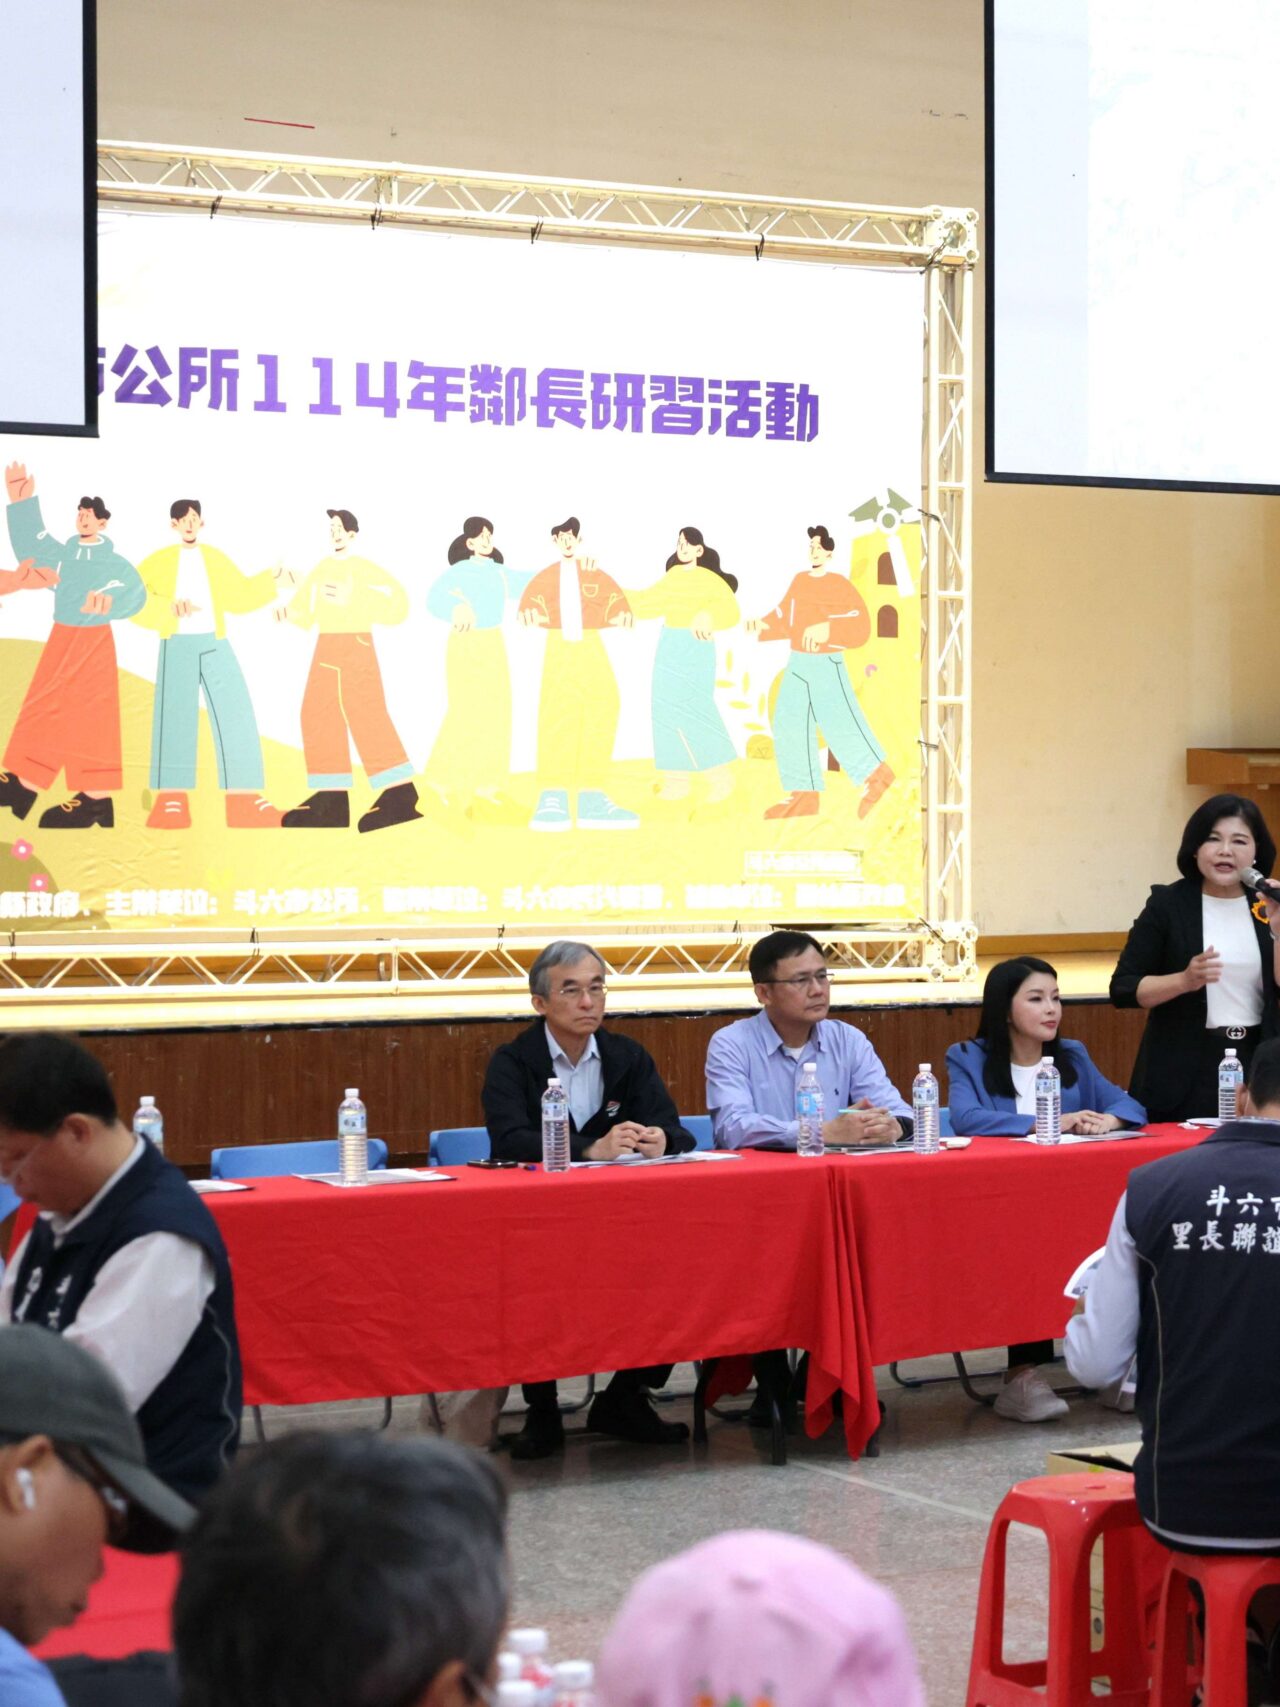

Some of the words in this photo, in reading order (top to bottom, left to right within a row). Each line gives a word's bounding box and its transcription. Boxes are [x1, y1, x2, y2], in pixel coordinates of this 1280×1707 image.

[98, 343, 820, 443] 公所114年鄰長研習活動
